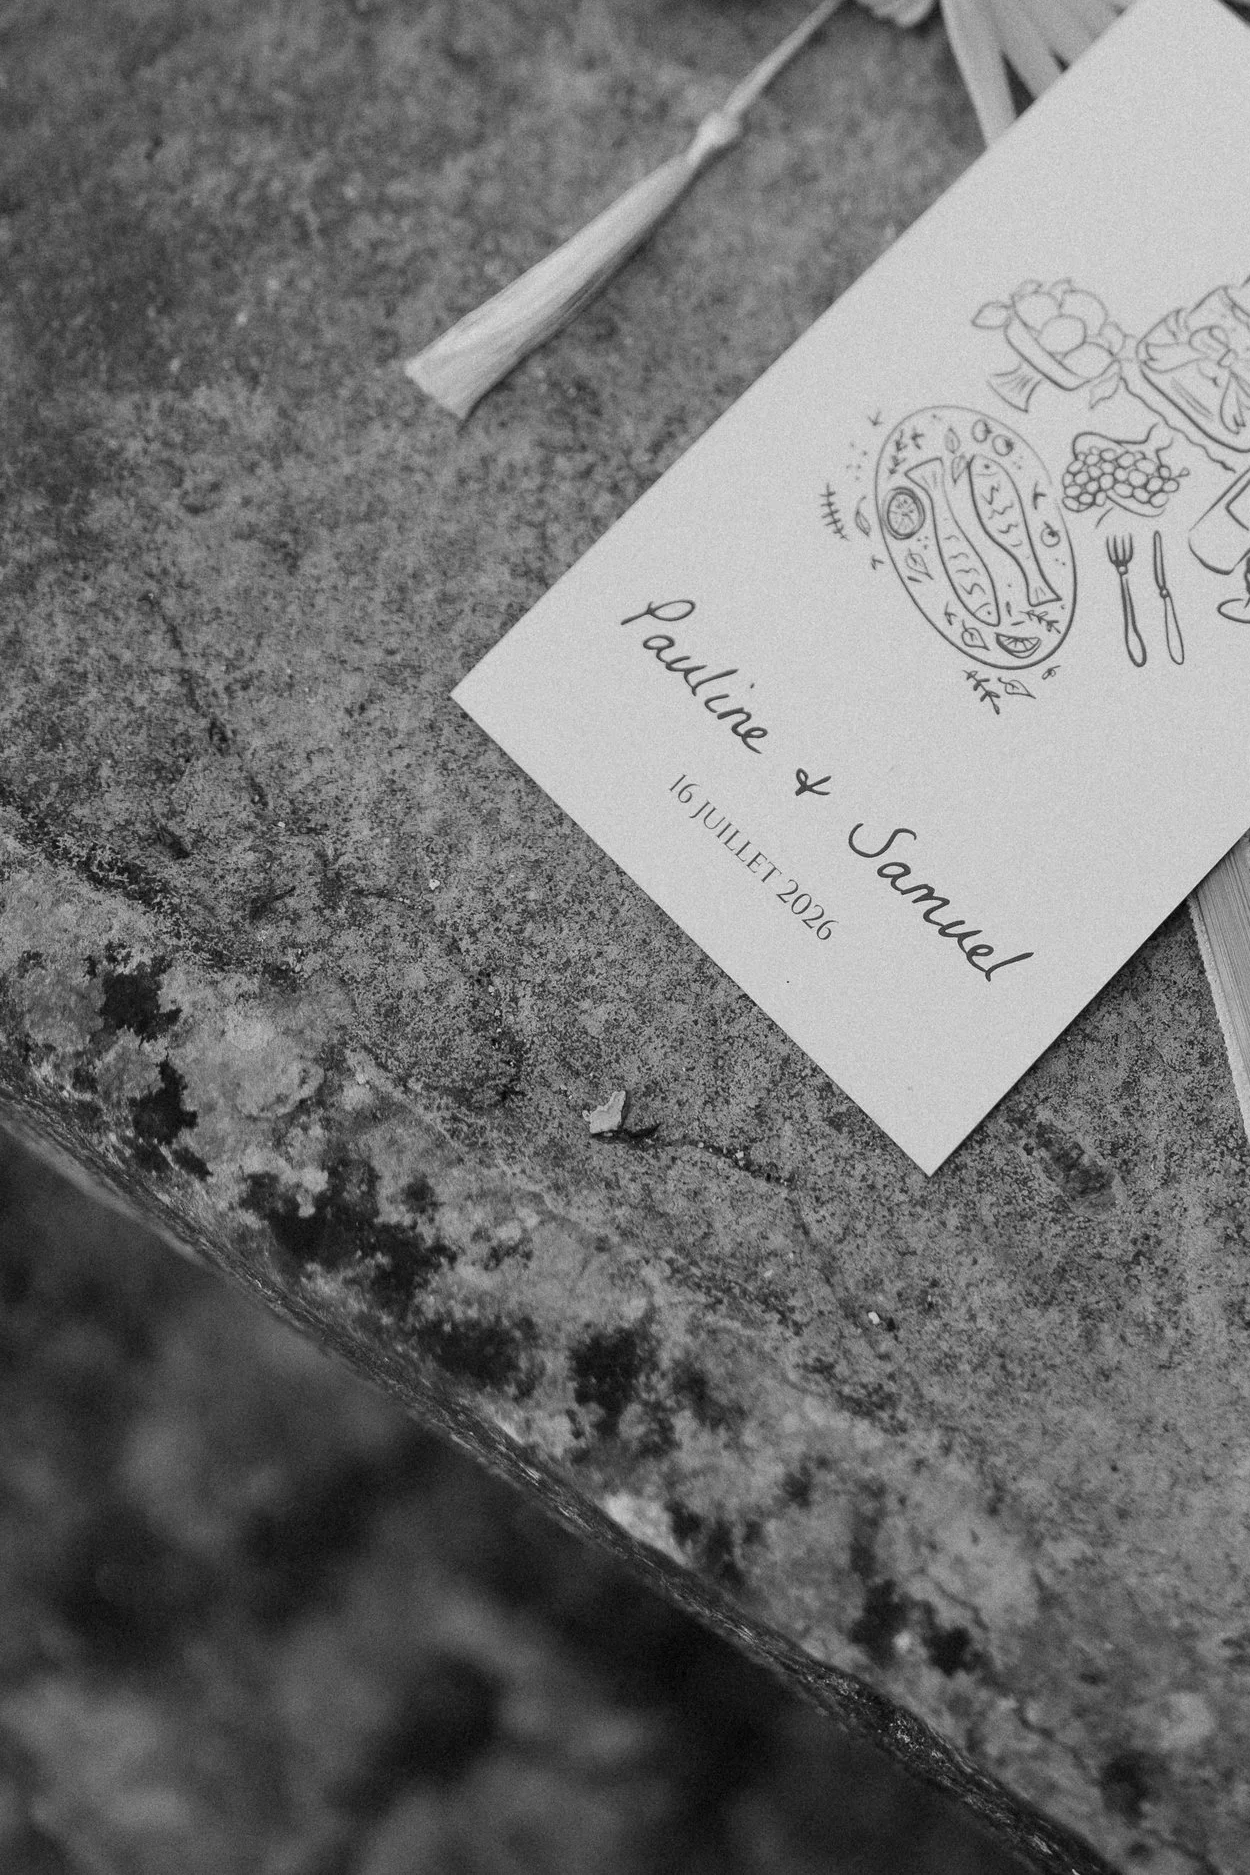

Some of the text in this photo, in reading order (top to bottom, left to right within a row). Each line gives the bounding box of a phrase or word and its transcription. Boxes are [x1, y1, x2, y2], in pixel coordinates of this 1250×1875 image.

[620, 599, 1035, 982] Pauline & Samuel
[669, 773, 839, 942] 16 JUILLET 2026
